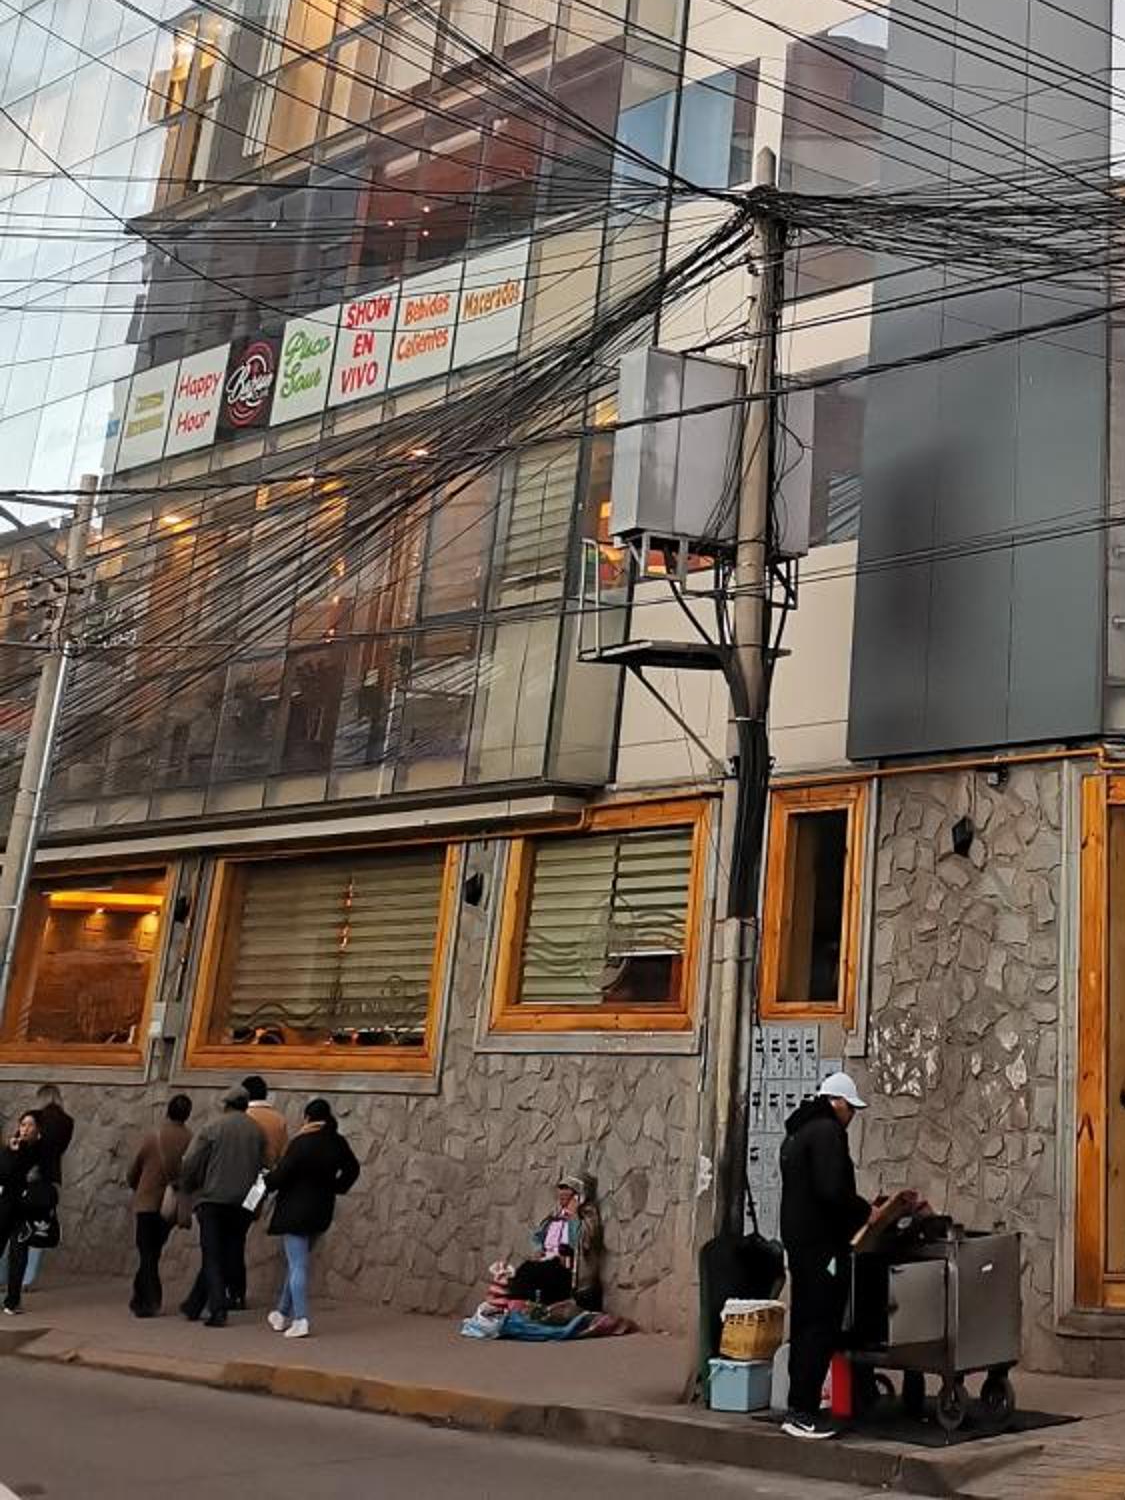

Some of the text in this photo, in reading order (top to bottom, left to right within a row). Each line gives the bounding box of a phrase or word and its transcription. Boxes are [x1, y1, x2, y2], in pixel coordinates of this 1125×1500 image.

[345, 294, 393, 329] SHOW
[404, 293, 450, 326] Bebidas
[462, 281, 521, 319] Macerados
[285, 331, 331, 366] Pisco
[352, 332, 375, 358] EN
[395, 328, 450, 362] Calientes
[177, 371, 224, 401] Happy
[280, 362, 322, 398] Sour
[341, 361, 379, 394] VIVO
[175, 409, 210, 436] Hour
